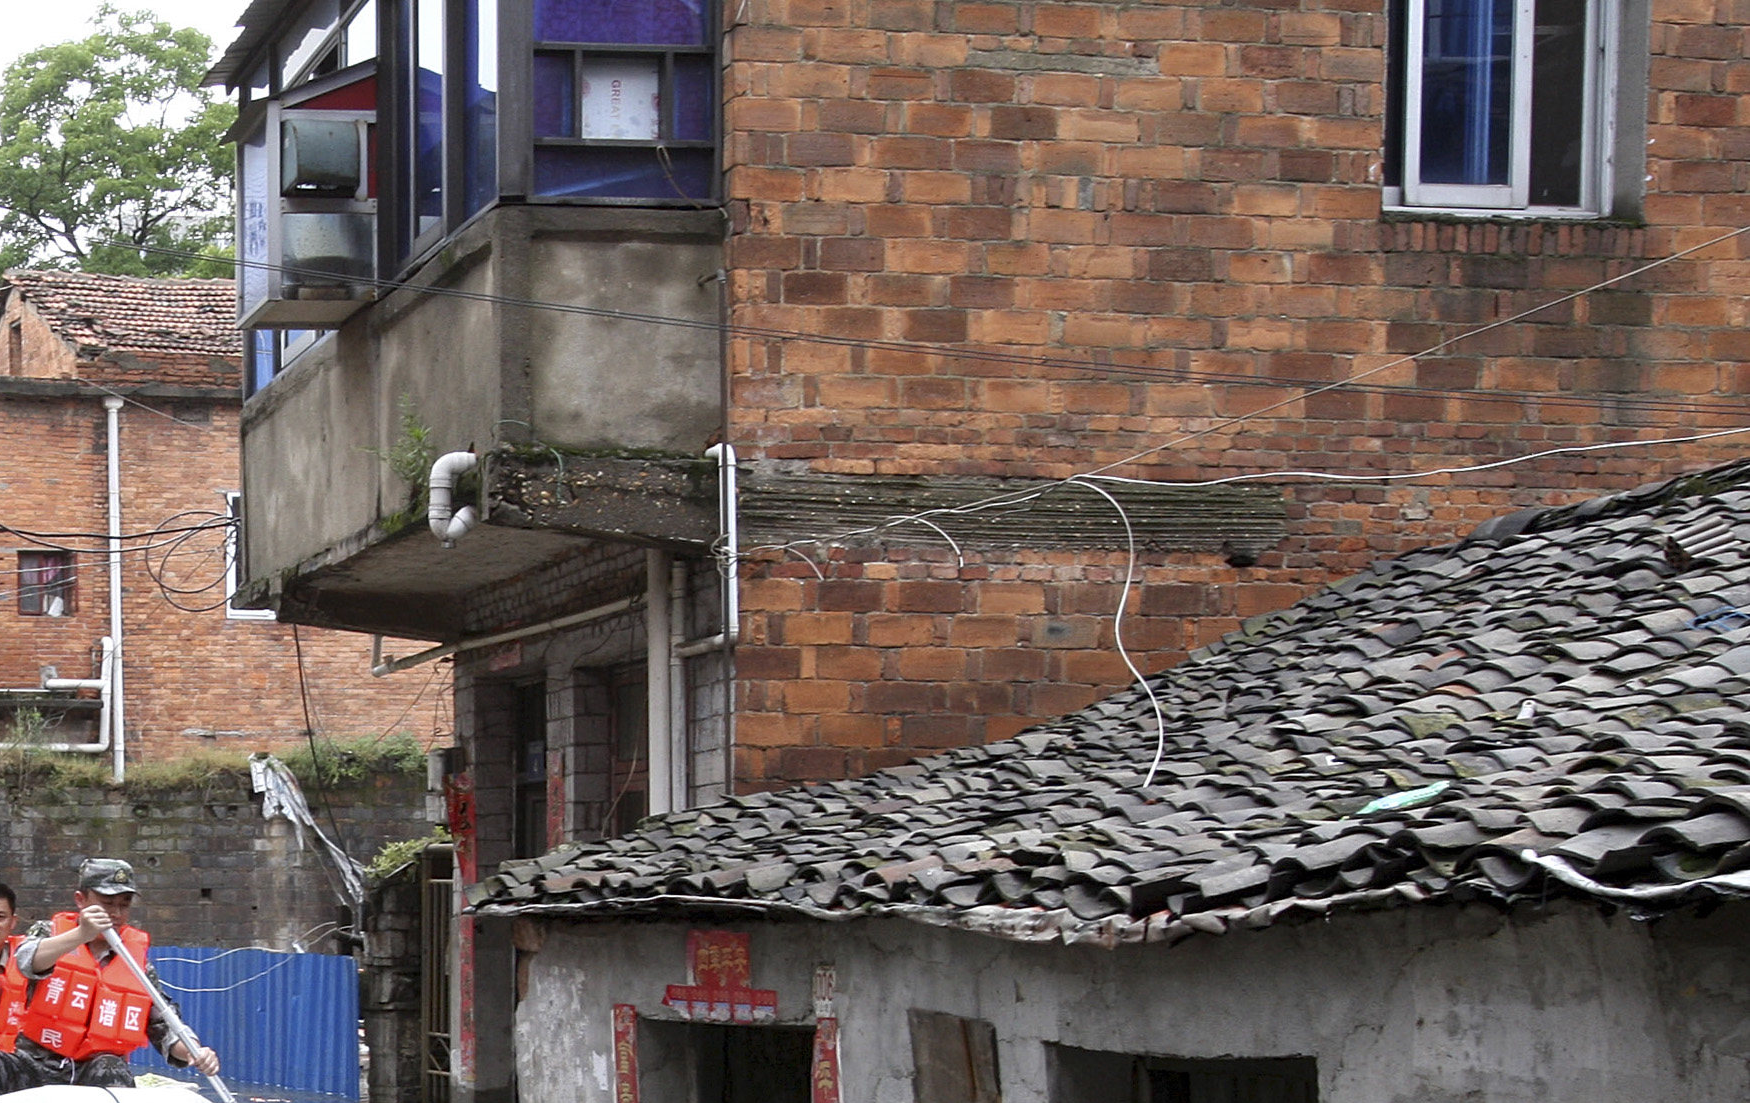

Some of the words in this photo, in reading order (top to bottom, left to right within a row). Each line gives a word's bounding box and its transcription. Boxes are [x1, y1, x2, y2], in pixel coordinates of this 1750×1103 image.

[45, 977, 143, 1031] 青云谱区
[41, 1028, 63, 1048] 民
